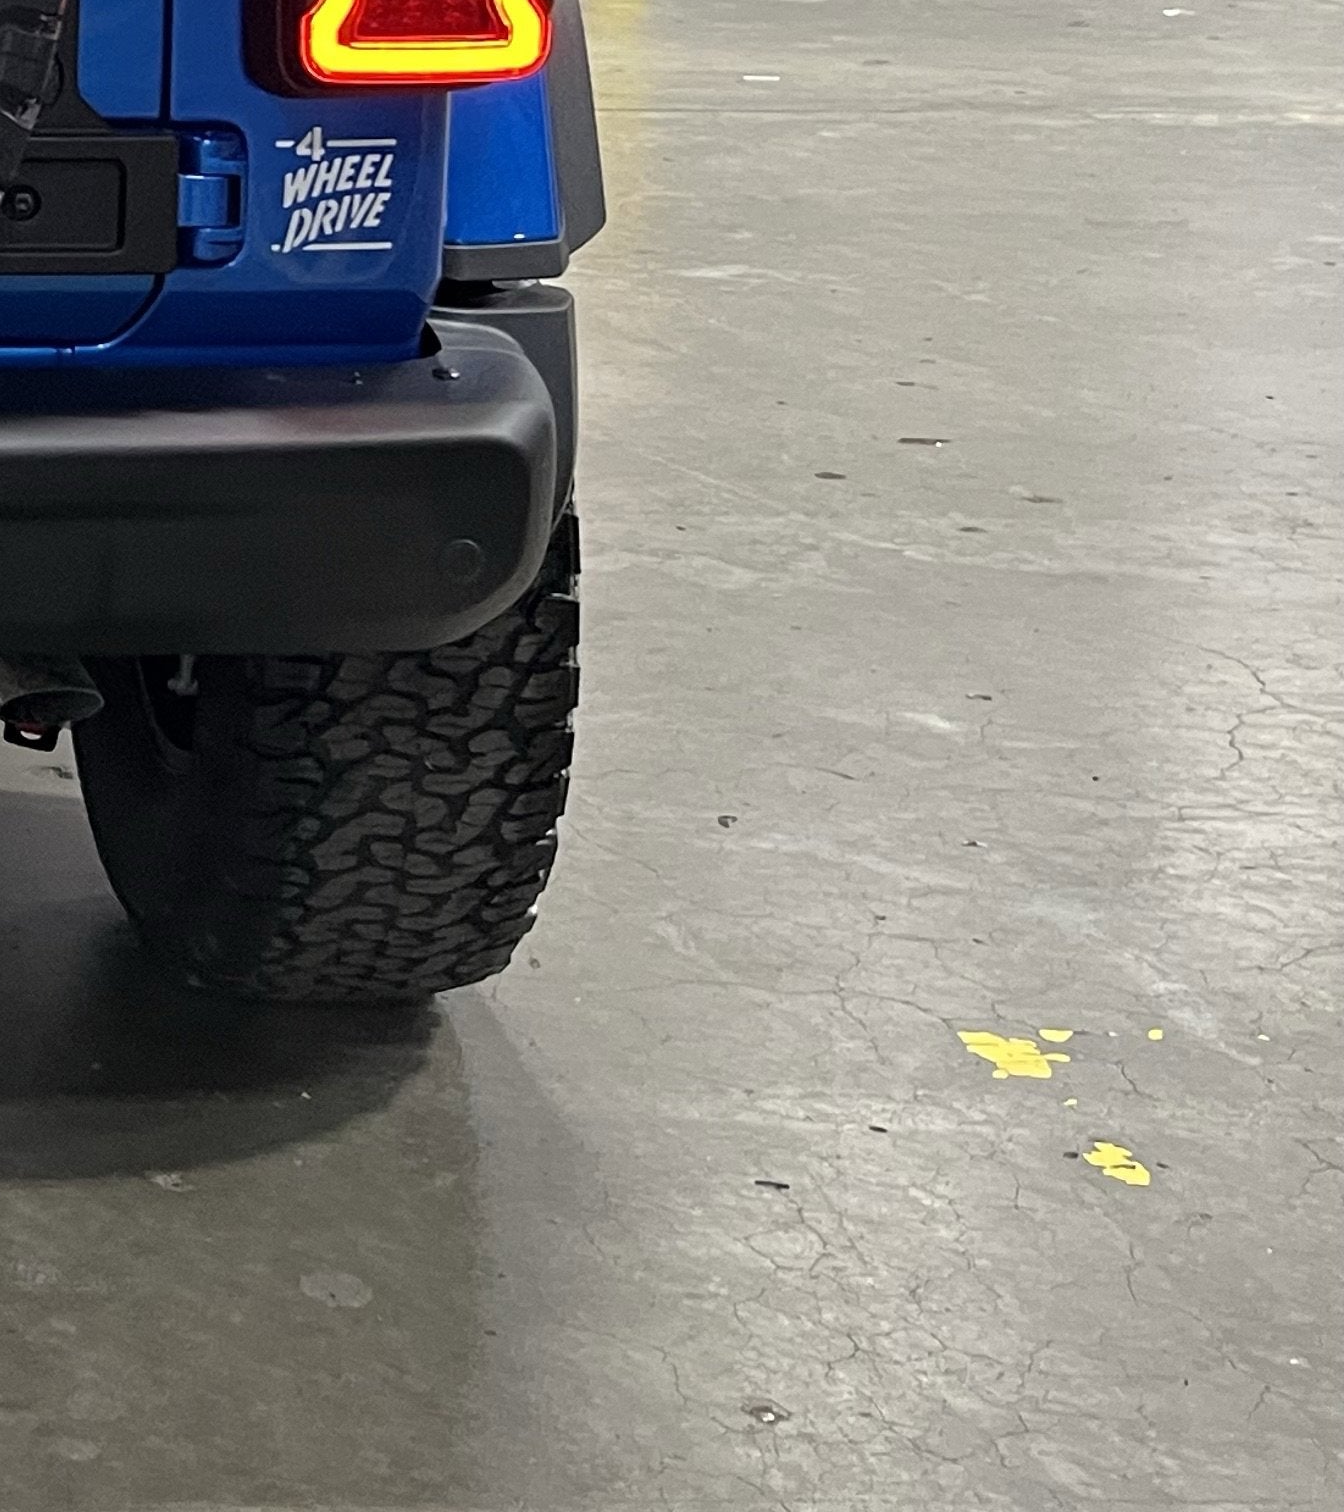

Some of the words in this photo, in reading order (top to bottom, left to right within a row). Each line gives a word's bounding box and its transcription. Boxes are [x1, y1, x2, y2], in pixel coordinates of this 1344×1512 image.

[296, 126, 326, 161] 4
[282, 153, 394, 208] WHEEL
[282, 192, 392, 253] DRIVE
